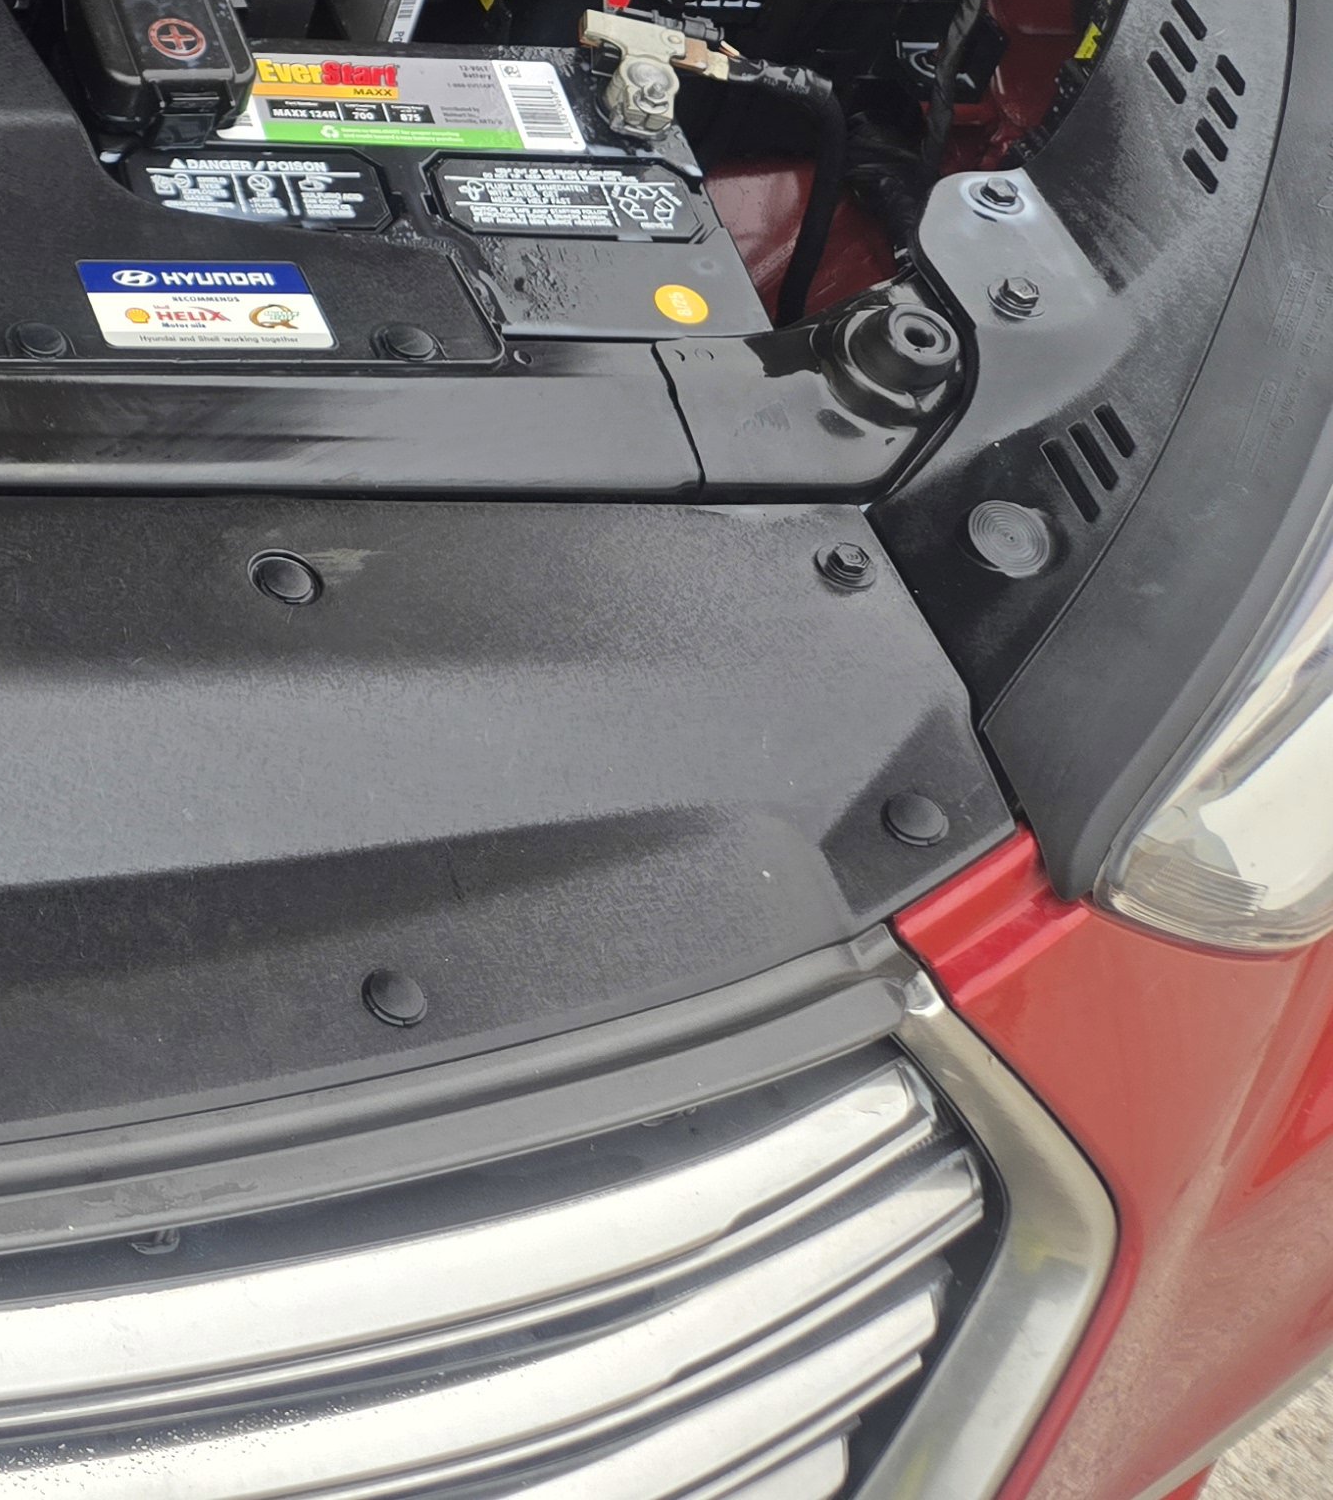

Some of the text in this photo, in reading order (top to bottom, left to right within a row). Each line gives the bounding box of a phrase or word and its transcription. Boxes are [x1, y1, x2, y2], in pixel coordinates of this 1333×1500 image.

[256, 58, 399, 86] EverStart
[353, 88, 392, 96] MAXX
[273, 108, 337, 119] MAXX 124R
[352, 112, 375, 120] 700
[185, 159, 252, 170] DANGER
[266, 161, 327, 172] POISON
[161, 272, 275, 286] HYUNDAI
[155, 310, 228, 322] HELIX
[139, 335, 177, 343] Hyundai
[223, 336, 259, 344] working
[261, 336, 299, 344] together
